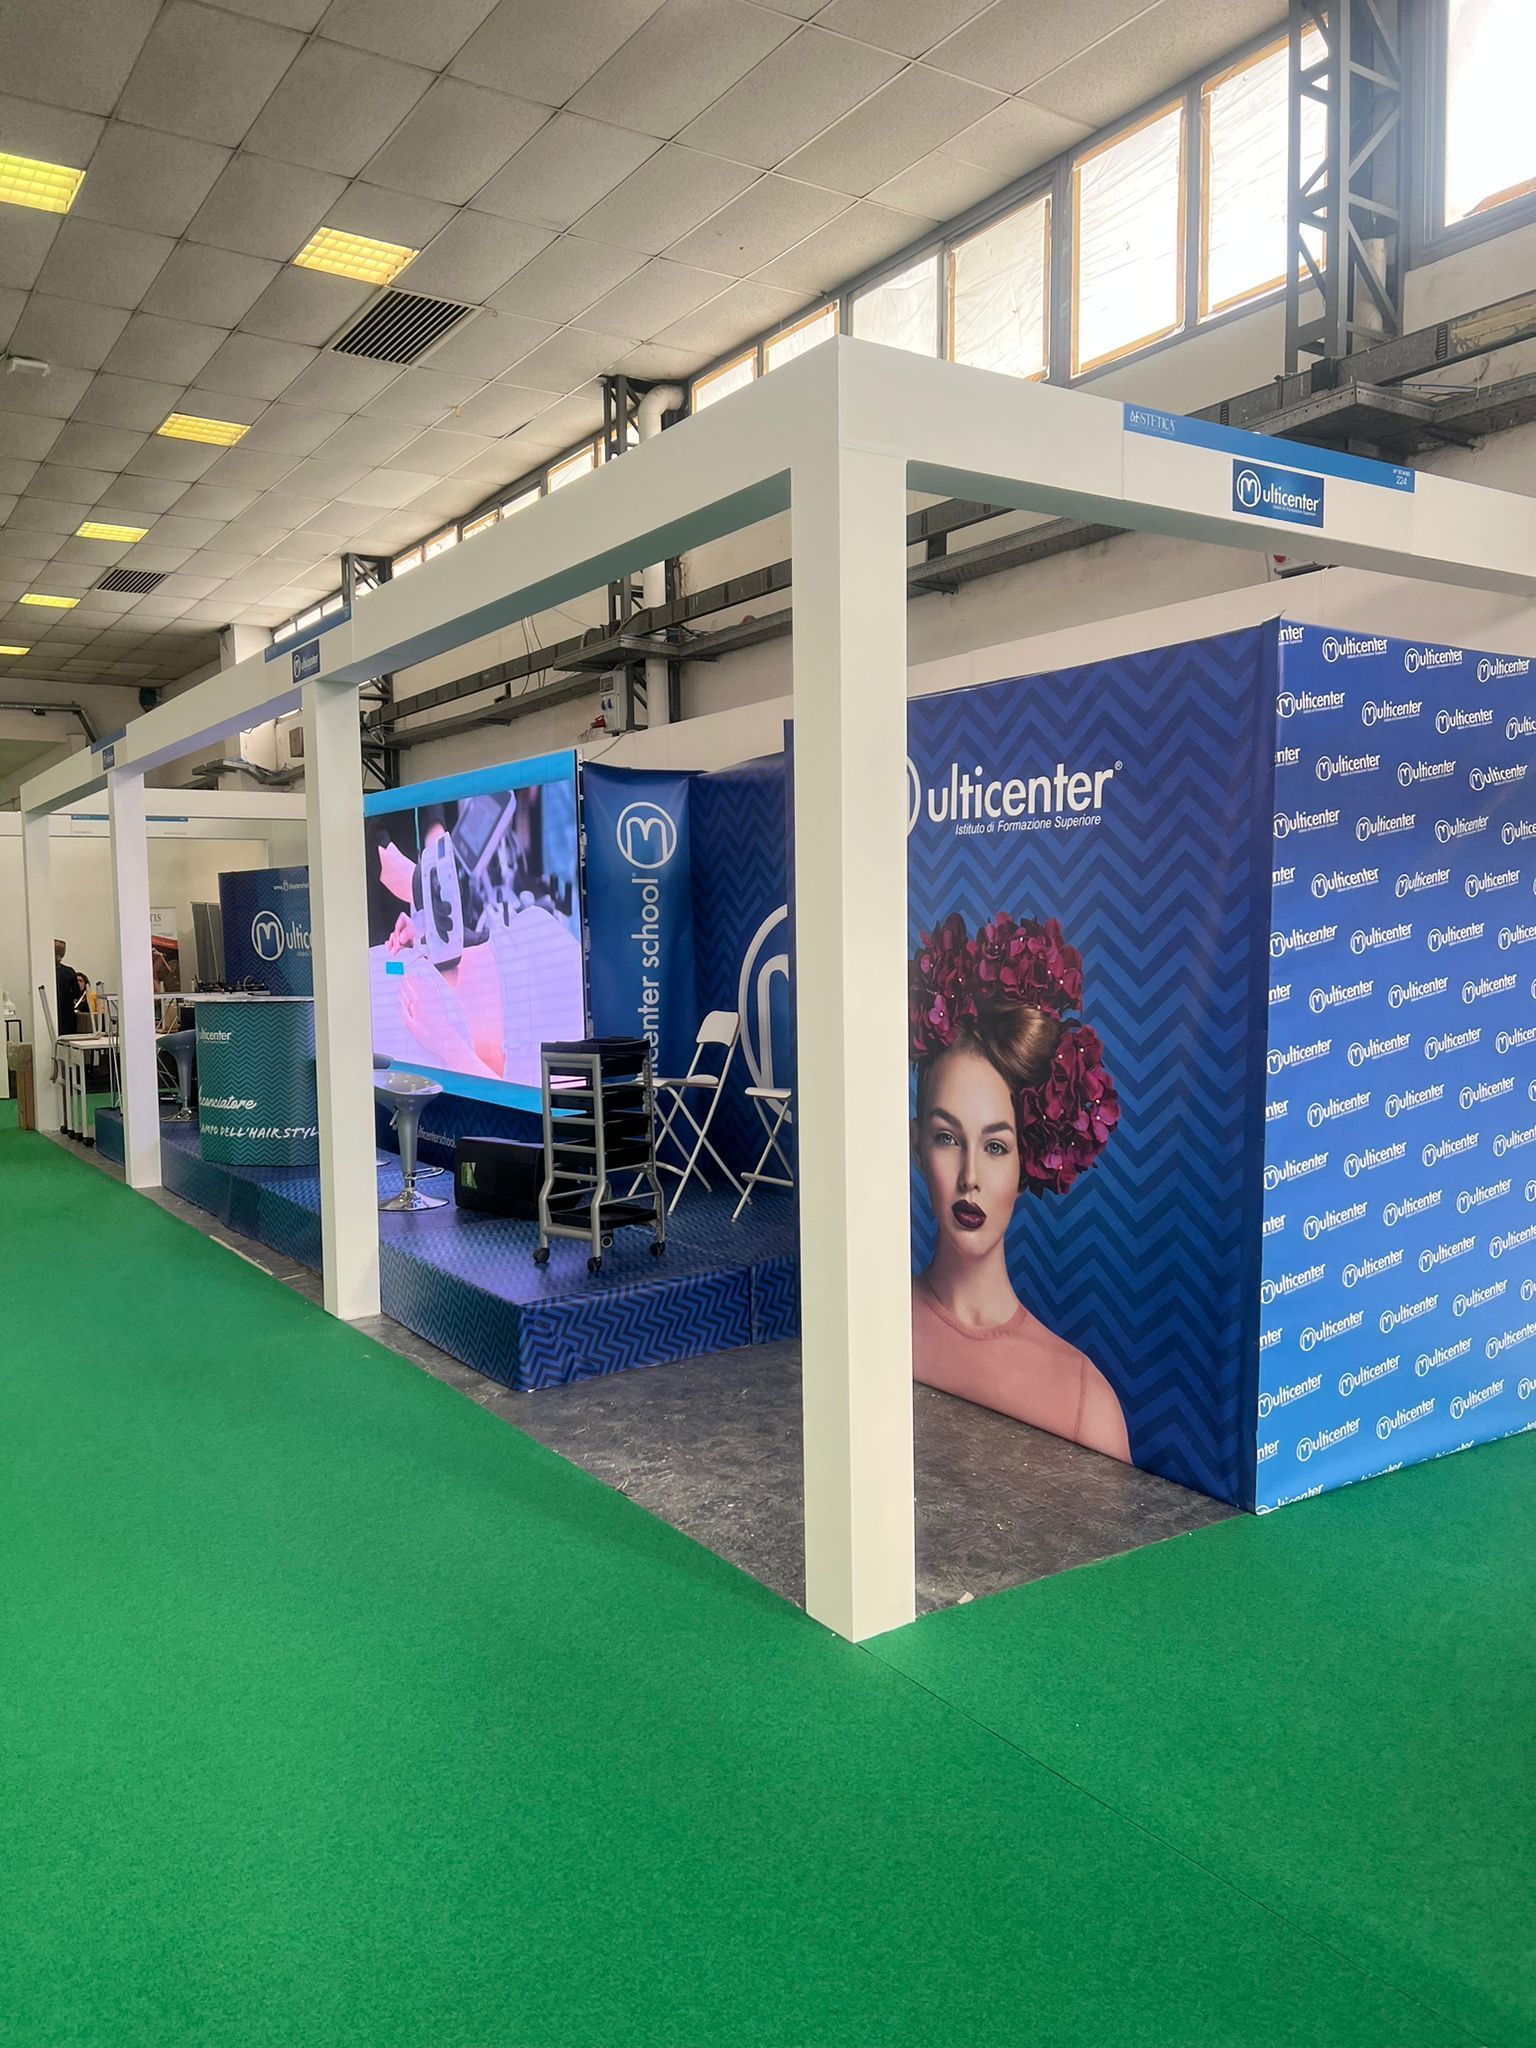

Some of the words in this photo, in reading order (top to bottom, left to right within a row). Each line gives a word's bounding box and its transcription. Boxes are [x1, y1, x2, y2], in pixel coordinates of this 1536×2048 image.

[1236, 469, 1320, 512] Multicenter
[1396, 475, 1408, 486] 224
[1278, 625, 1304, 641] nter
[1322, 637, 1387, 662] Multicenter
[1405, 648, 1462, 673] Multicenter
[1477, 659, 1529, 682] Multicenter
[1276, 690, 1345, 719] Multicenter
[1362, 700, 1422, 726] Multicenter
[1435, 709, 1493, 734] Multicenter
[1275, 747, 1300, 763] nter
[1316, 754, 1380, 781] Multicenter
[1398, 760, 1456, 786] Multicenter
[1469, 764, 1527, 791] Multicenter
[955, 823, 985, 836] Istituto
[986, 821, 995, 833] di
[997, 817, 1051, 832] Formazione
[1054, 814, 1102, 828] Superiore
[1273, 809, 1340, 838] Multicenter
[1356, 813, 1415, 841] Multicenter
[1435, 816, 1489, 843] Multicenter
[1311, 868, 1378, 898] Multicenter
[1395, 869, 1450, 897] Multicenter
[1465, 870, 1520, 897] Multicenter
[251, 911, 312, 960] Multic
[1270, 925, 1338, 957] Multicenter
[1350, 924, 1412, 954] Multicenter
[1428, 923, 1484, 952] Multicenter
[1309, 980, 1374, 1013] Multicenter
[1388, 977, 1448, 1008] Multicenter
[1462, 974, 1517, 1004] Multicenter
[1267, 1039, 1332, 1075] Multicenter
[1347, 1033, 1410, 1067] Multicenter
[1425, 1028, 1481, 1060] Multicenter
[1385, 1084, 1444, 1118] Multicenter
[1459, 1077, 1514, 1109] Multicenter
[1307, 1092, 1371, 1127] Multicenter
[1344, 1142, 1406, 1178] Multicenter
[1422, 1133, 1479, 1167] Multicenter
[1264, 1152, 1329, 1190] Multicenter
[1383, 1190, 1442, 1226] Multicenter
[1456, 1179, 1511, 1213] Multicenter
[1303, 1202, 1367, 1240] Multicenter
[1342, 1249, 1404, 1288] Multicenter
[1419, 1236, 1475, 1272] Multicenter
[1261, 1263, 1326, 1305] Multicenter
[1453, 1280, 1507, 1316] Multicenter
[1379, 1295, 1438, 1333] Multicenter
[1300, 1311, 1364, 1351] Multicenter
[1415, 1338, 1472, 1377] Multicenter
[1338, 1355, 1400, 1396] Multicenter
[1257, 1374, 1323, 1418] Multicenter
[1450, 1379, 1504, 1419] Multicenter
[1376, 1398, 1435, 1440] Multicenter
[1296, 1418, 1360, 1462] Multicenter
